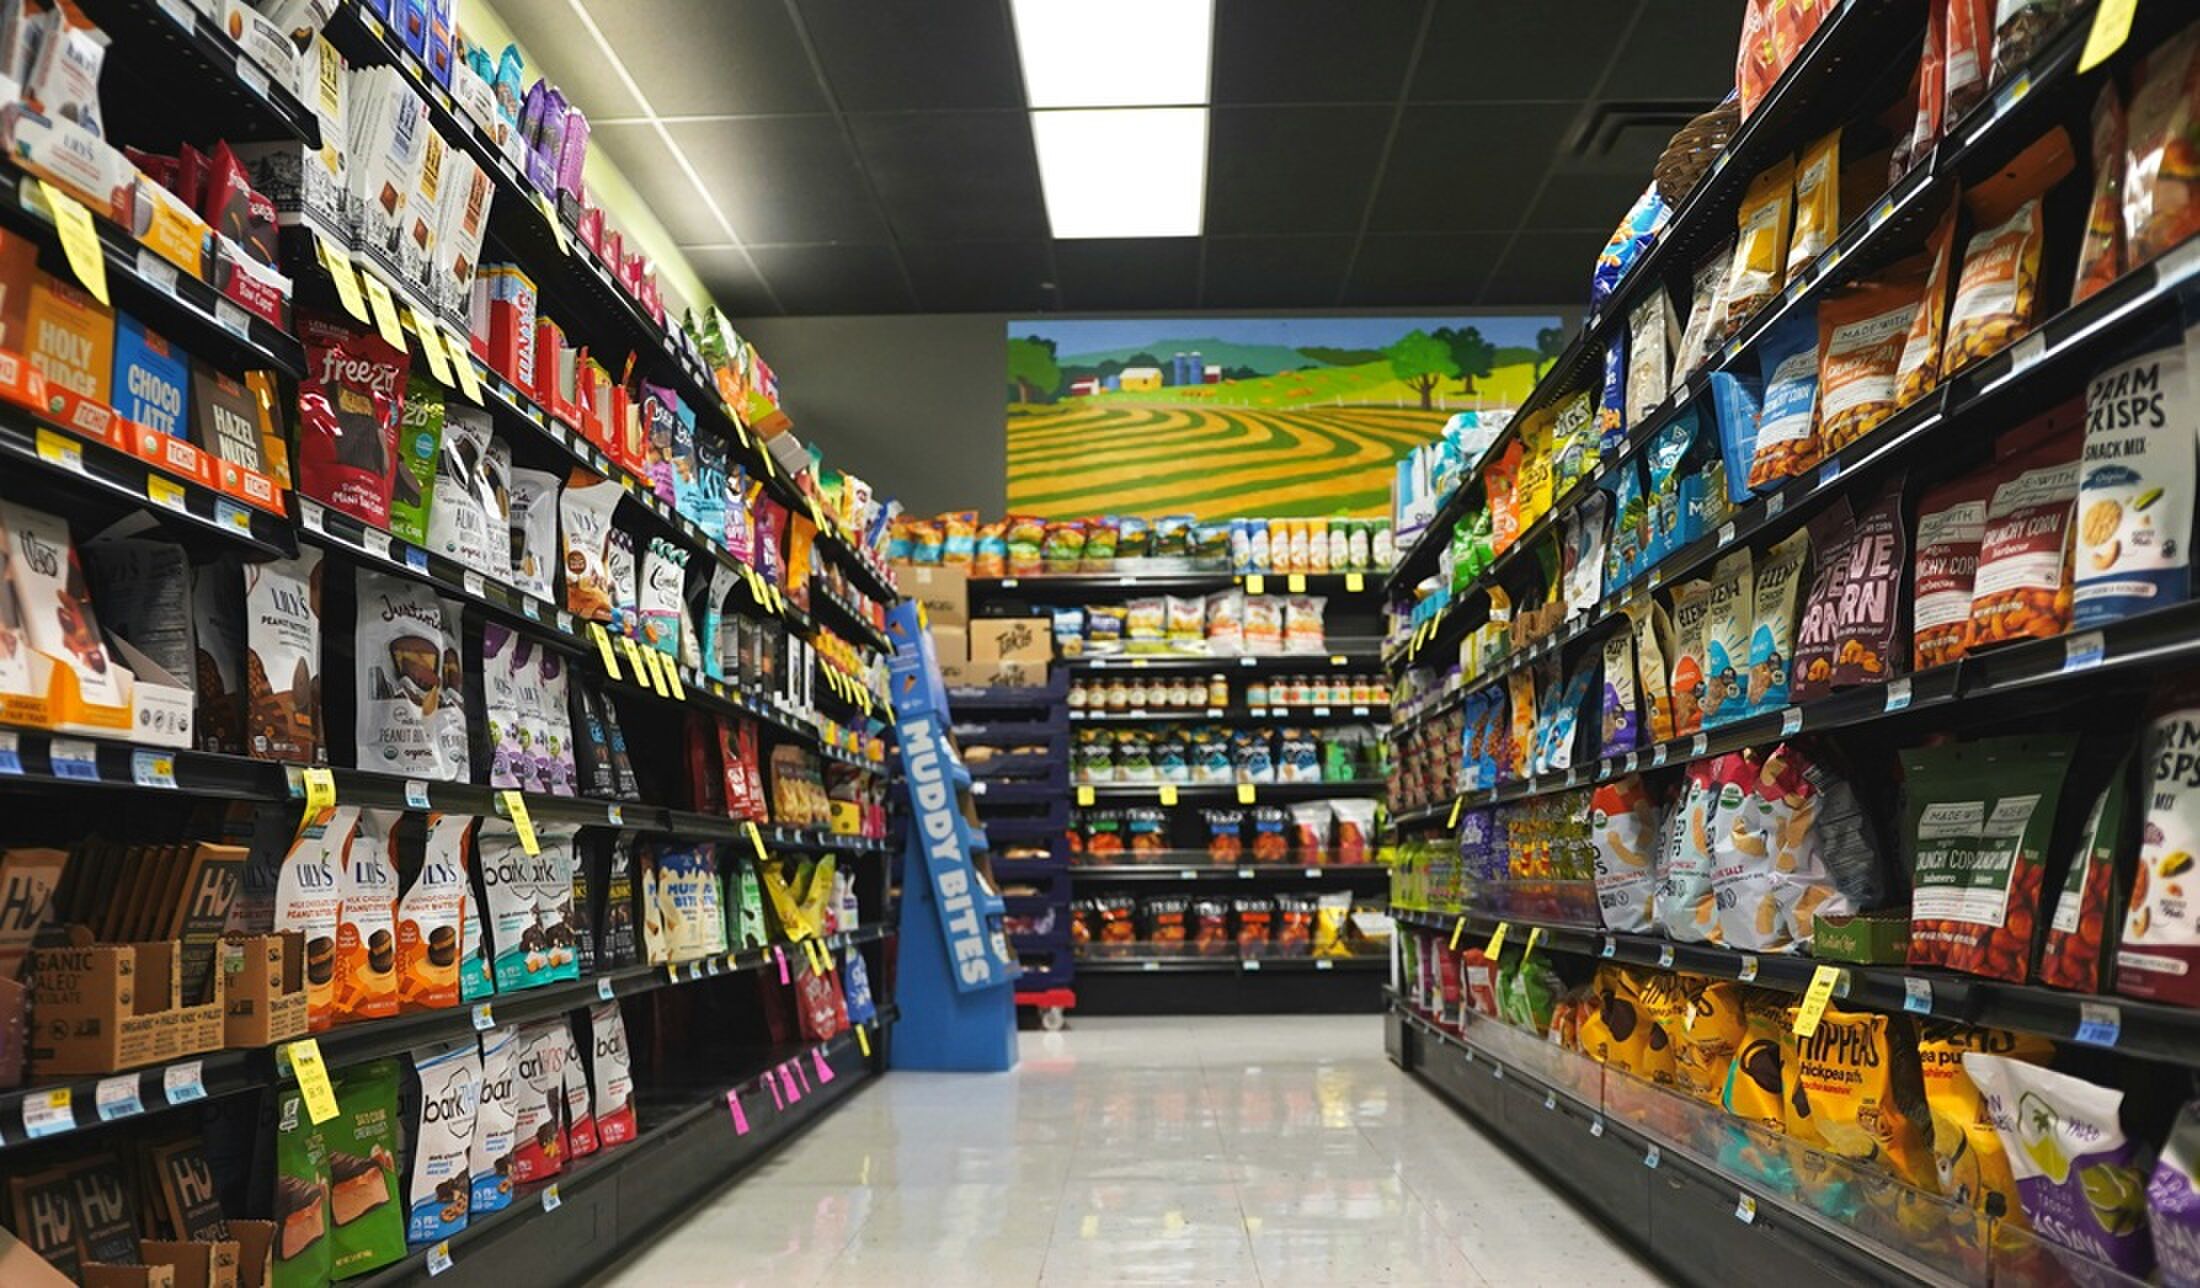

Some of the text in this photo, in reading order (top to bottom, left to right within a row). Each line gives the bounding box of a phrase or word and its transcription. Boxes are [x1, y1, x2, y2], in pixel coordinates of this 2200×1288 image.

[39, 320, 93, 369] HOLY
[128, 363, 181, 418] CHOCO
[133, 402, 175, 437] LATTE
[213, 403, 256, 449] HAZEL
[2124, 437, 2147, 457] MIX
[902, 719, 991, 985] MUDDY BITES
[421, 863, 458, 886] ILY'S
[1801, 1061, 1844, 1083] hickpea
